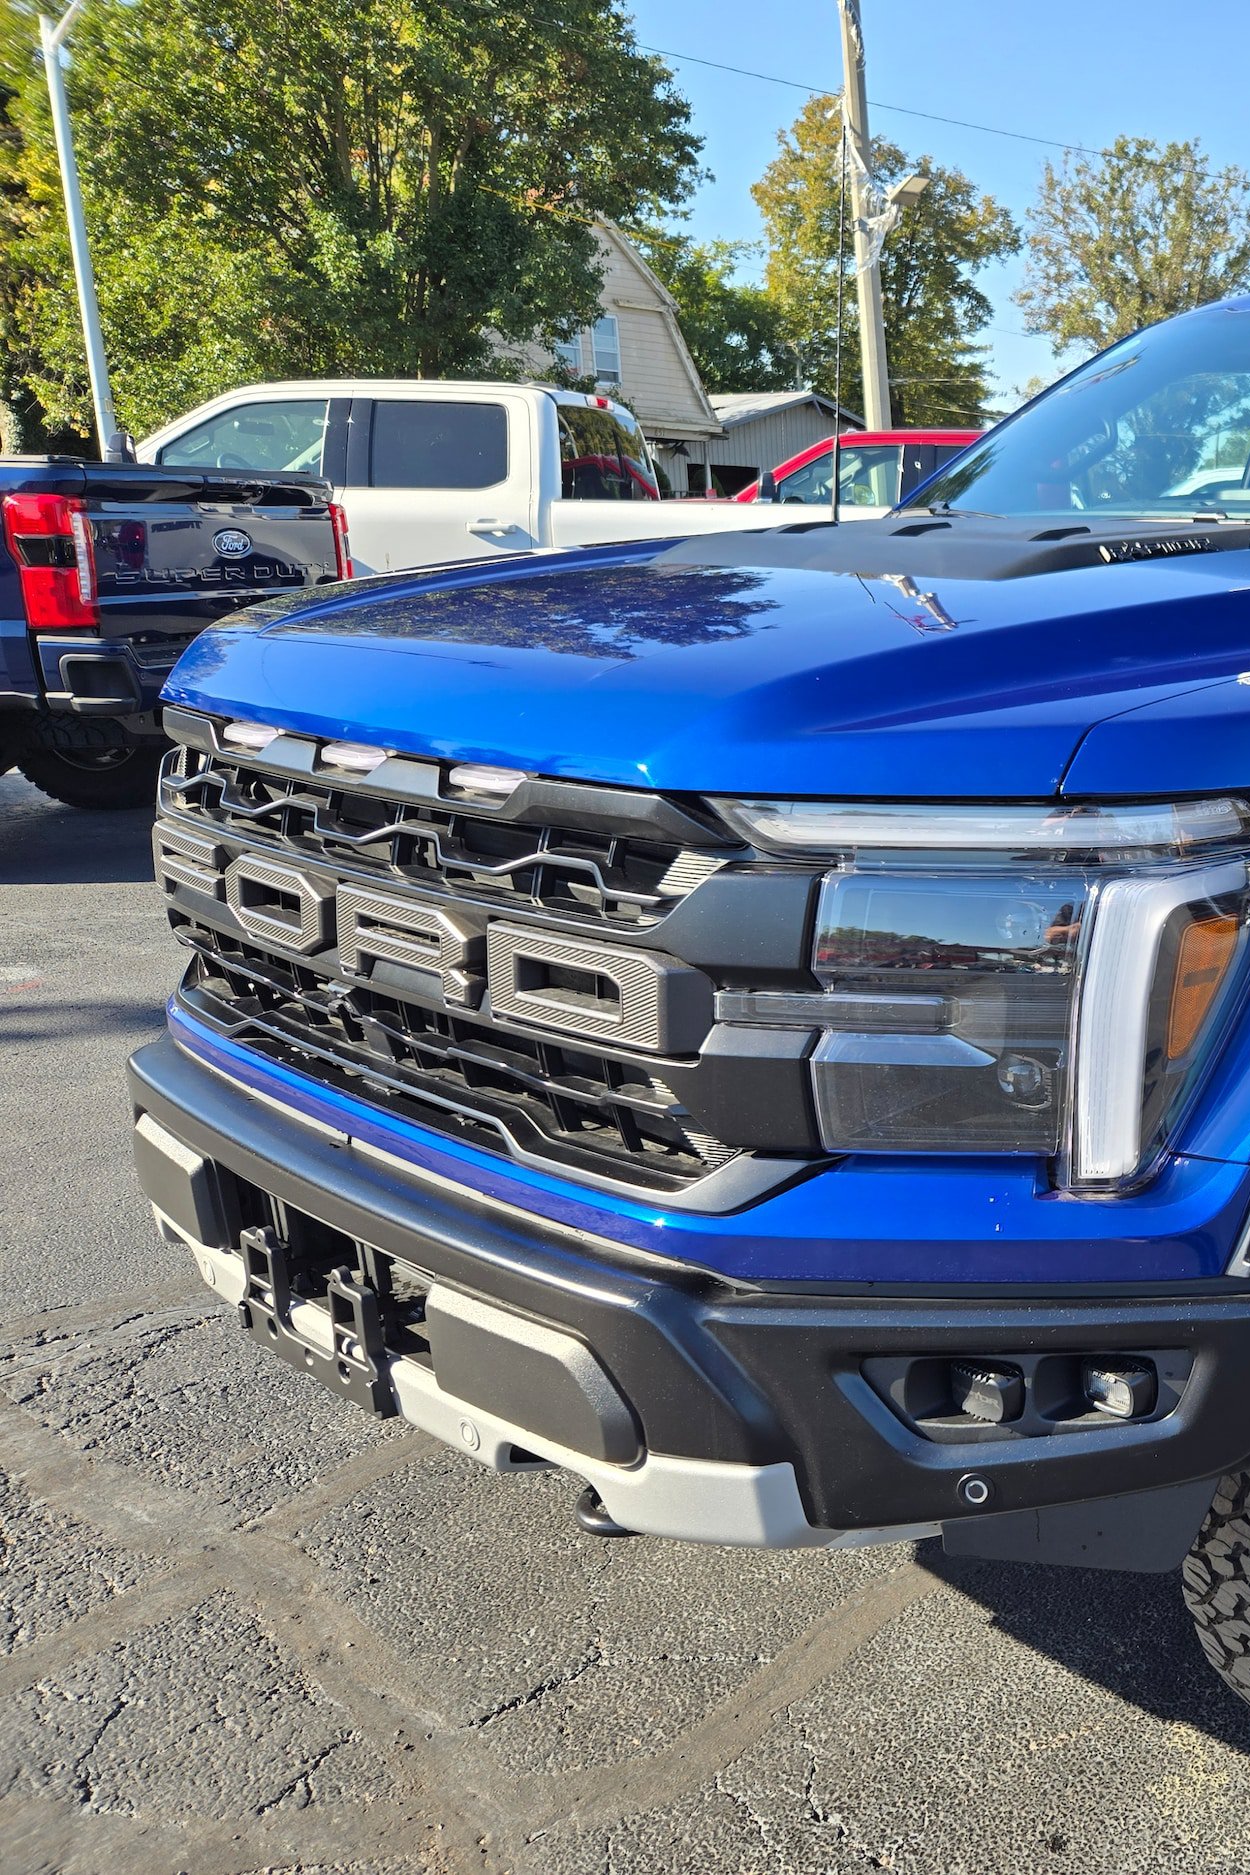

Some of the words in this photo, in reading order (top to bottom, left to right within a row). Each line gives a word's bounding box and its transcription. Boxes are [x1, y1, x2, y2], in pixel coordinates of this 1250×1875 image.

[221, 534, 244, 551] Ford
[115, 566, 245, 585] SUPER
[253, 562, 330, 580] DUTY
[152, 819, 716, 1053] FORD
